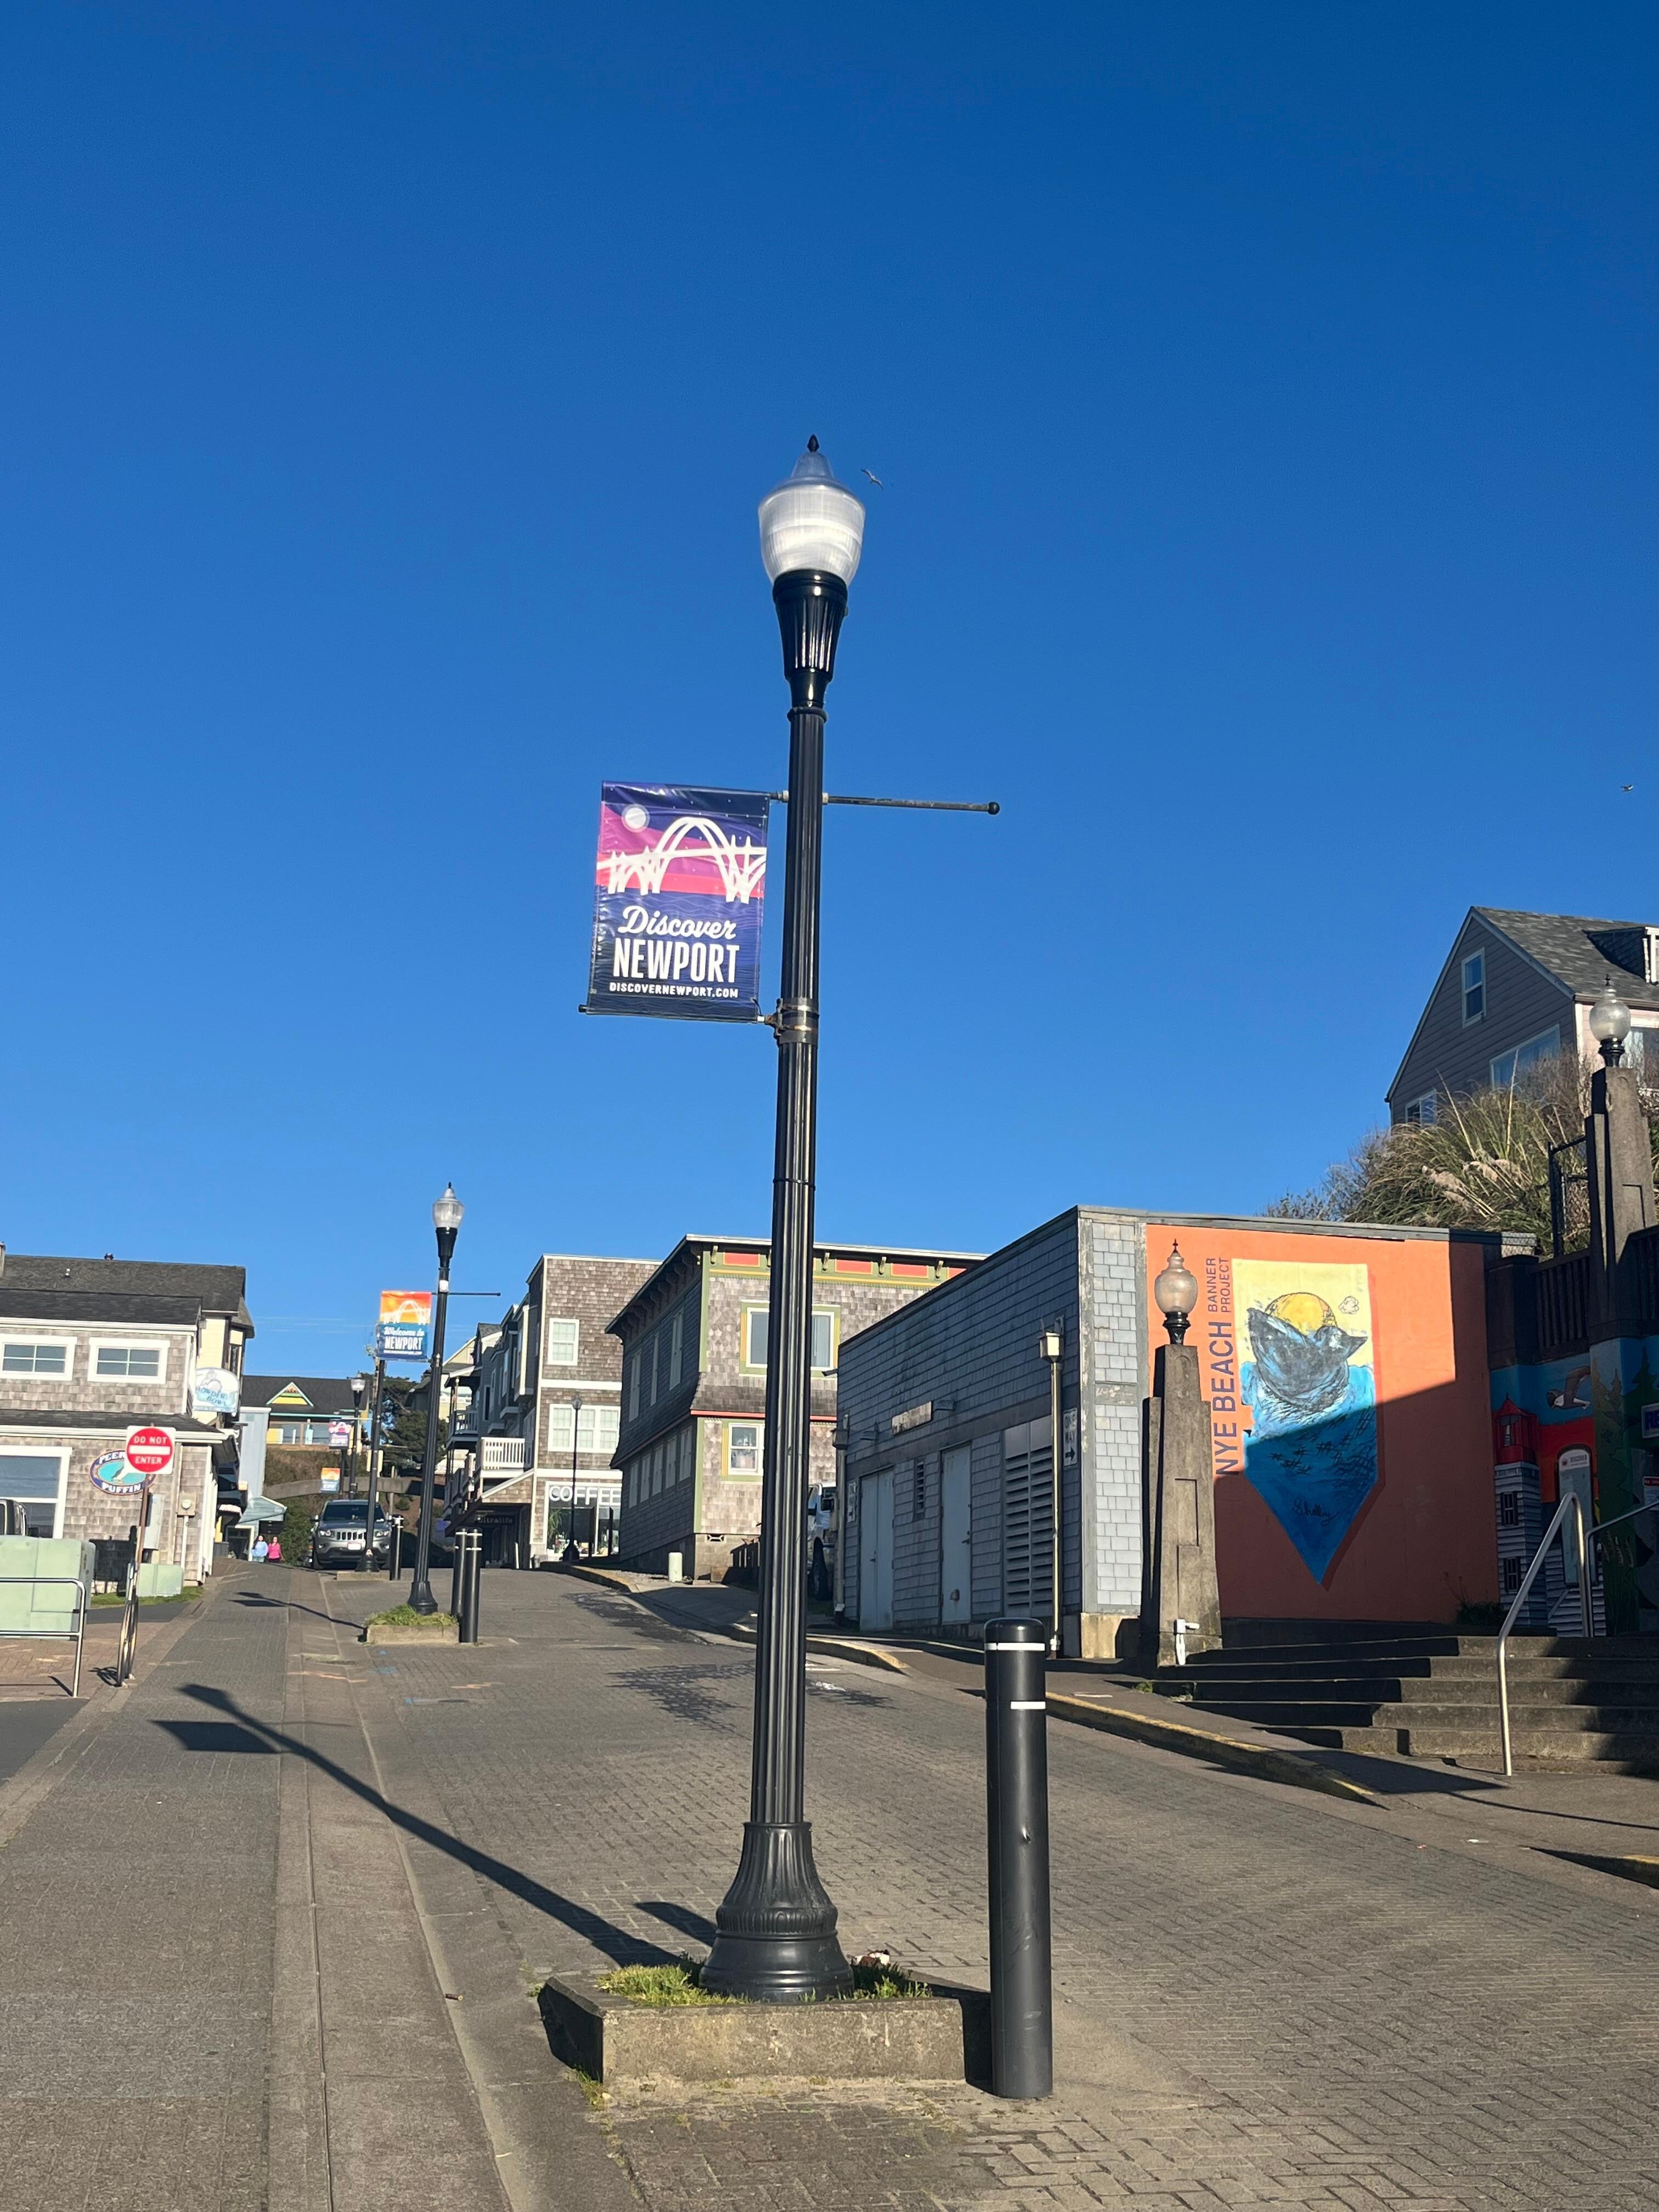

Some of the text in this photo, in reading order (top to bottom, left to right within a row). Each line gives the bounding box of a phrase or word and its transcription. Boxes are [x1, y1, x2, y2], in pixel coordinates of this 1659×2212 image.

[617, 905, 736, 939] Discover
[613, 938, 740, 983] NEWPORT
[609, 981, 738, 998] DISCOVERNEWPORT.COM
[1206, 1258, 1217, 1312] BANNER
[1219, 1257, 1231, 1312] PROJECT
[385, 1336, 424, 1350] NEWPORT
[195, 1387, 225, 1399] HOWDER
[1208, 1322, 1239, 1475] NYE BEACH
[149, 1436, 167, 1444] NOT
[135, 1456, 162, 1465] ENTER
[102, 1483, 141, 1493] PUFFIN
[549, 1486, 622, 1505] COFFEE
